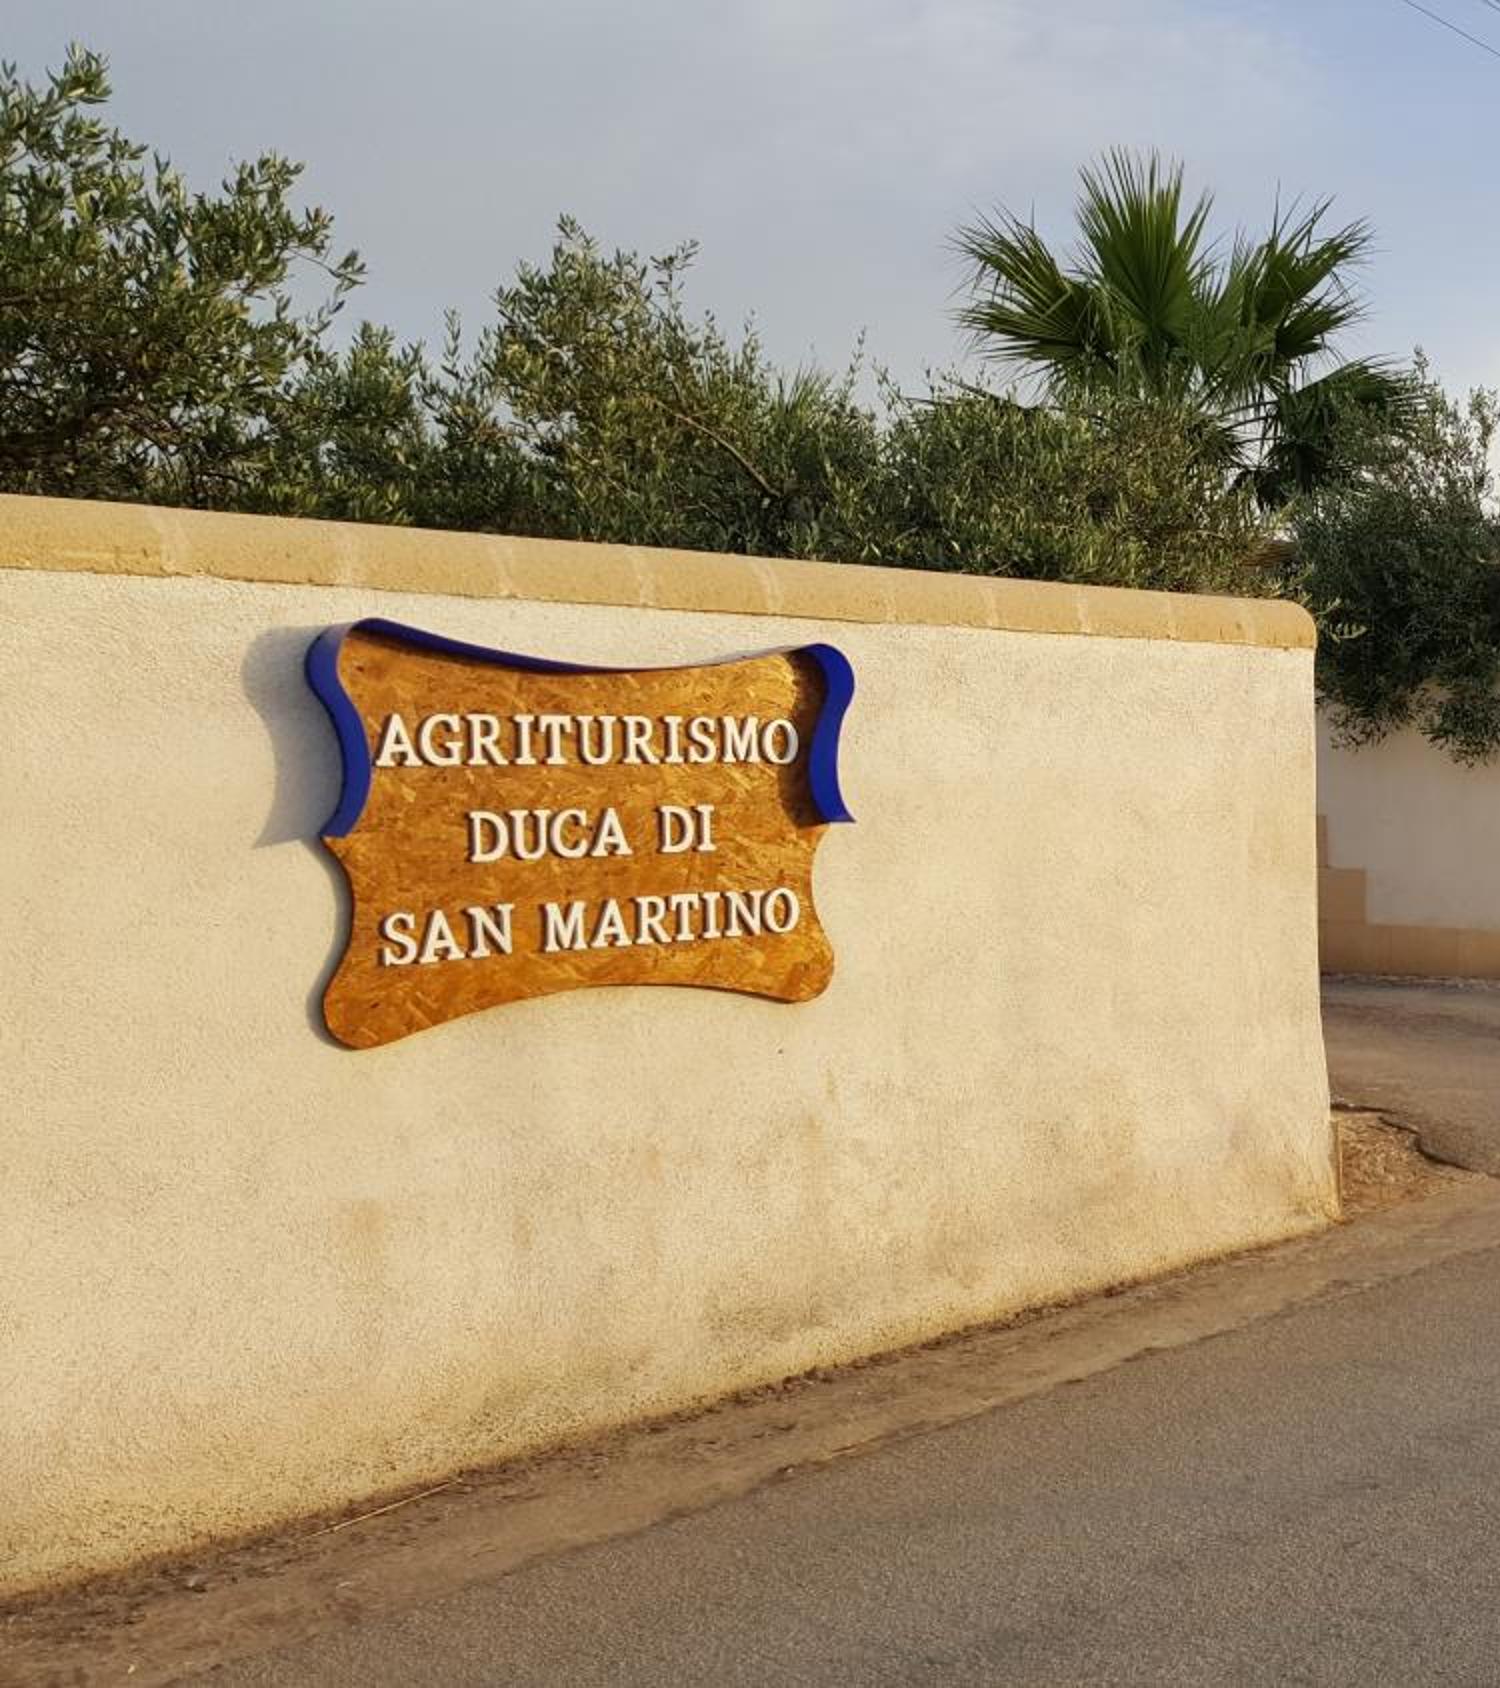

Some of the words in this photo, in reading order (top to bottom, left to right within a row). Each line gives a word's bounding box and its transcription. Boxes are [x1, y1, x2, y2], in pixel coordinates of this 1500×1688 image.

[374, 714, 799, 767] AGRITURISMO
[467, 807, 633, 863] DUCA
[657, 804, 718, 854] DI
[380, 903, 515, 967] SAN
[543, 887, 801, 954] MARTINO
